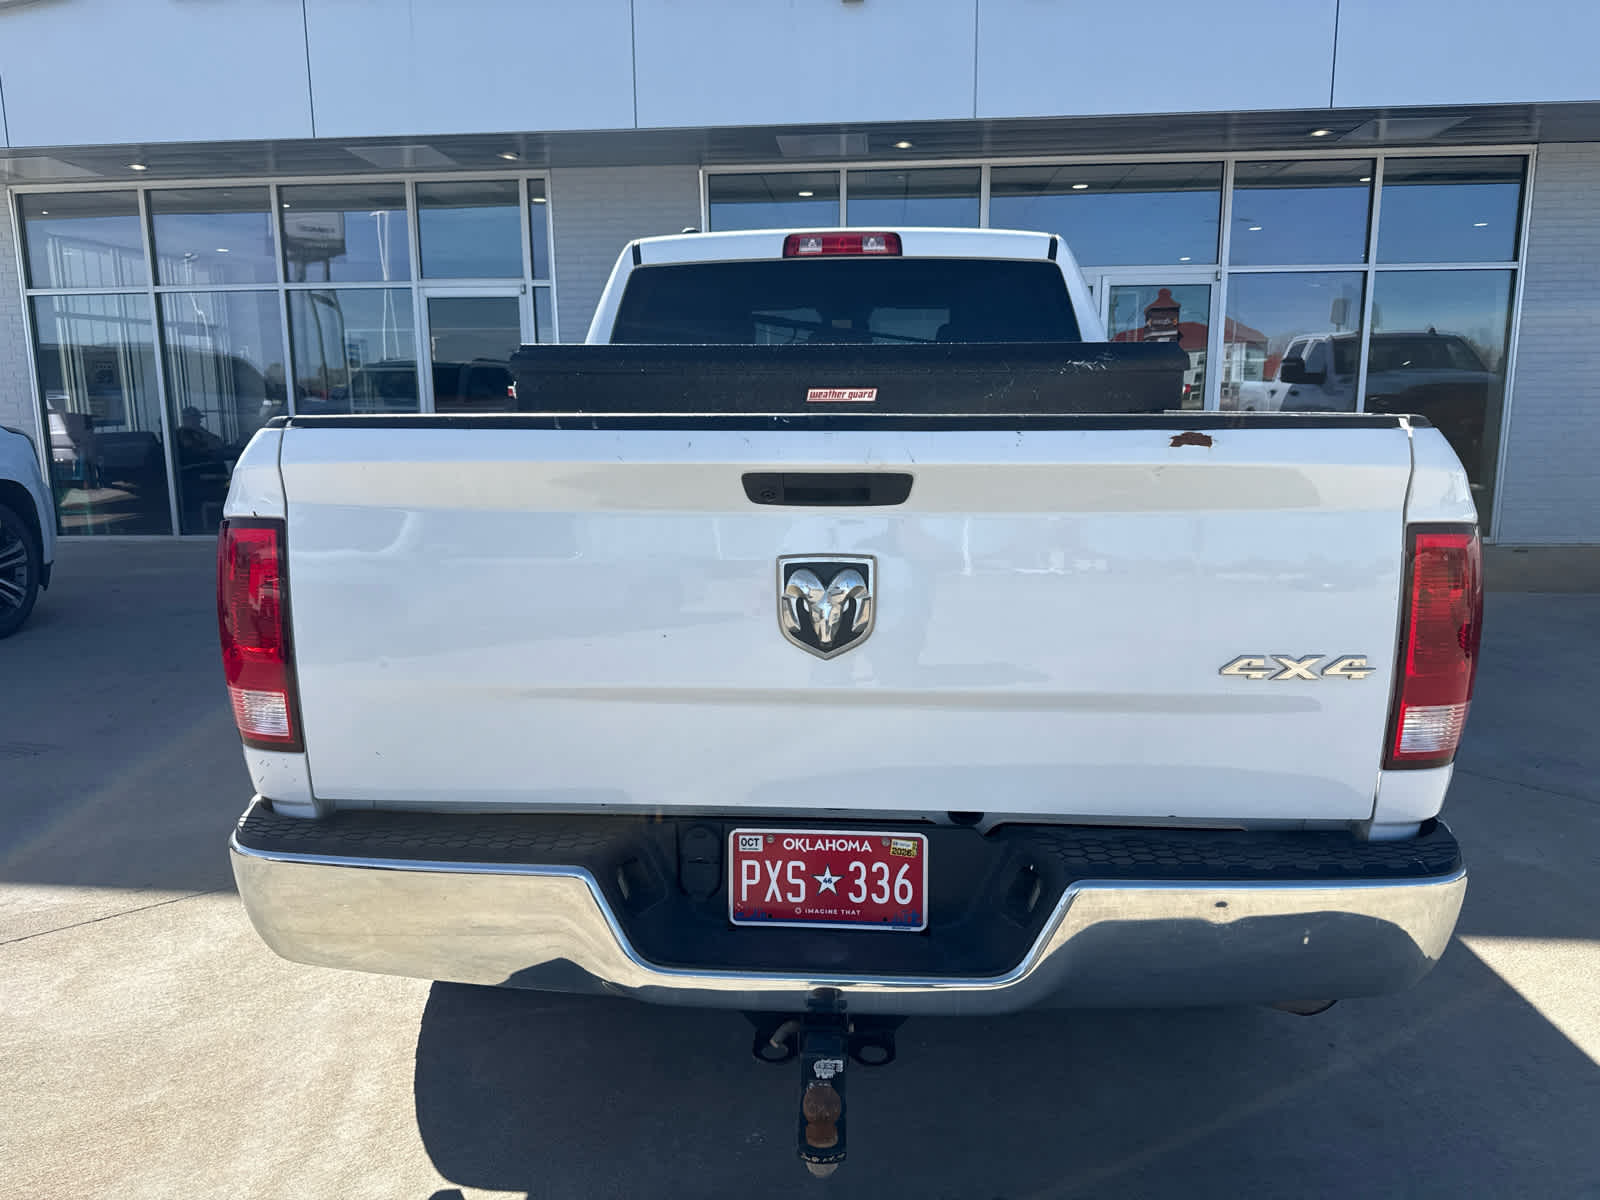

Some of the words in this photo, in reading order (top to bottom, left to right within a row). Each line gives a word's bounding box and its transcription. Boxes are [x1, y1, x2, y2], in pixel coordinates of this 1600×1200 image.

[809, 390, 846, 399] weather
[848, 390, 874, 400] guard
[1218, 653, 1377, 681] 4X4
[740, 837, 760, 848] OCT
[783, 838, 872, 852] OKLAHOMA
[741, 859, 807, 903] PXS
[848, 860, 914, 906] 336
